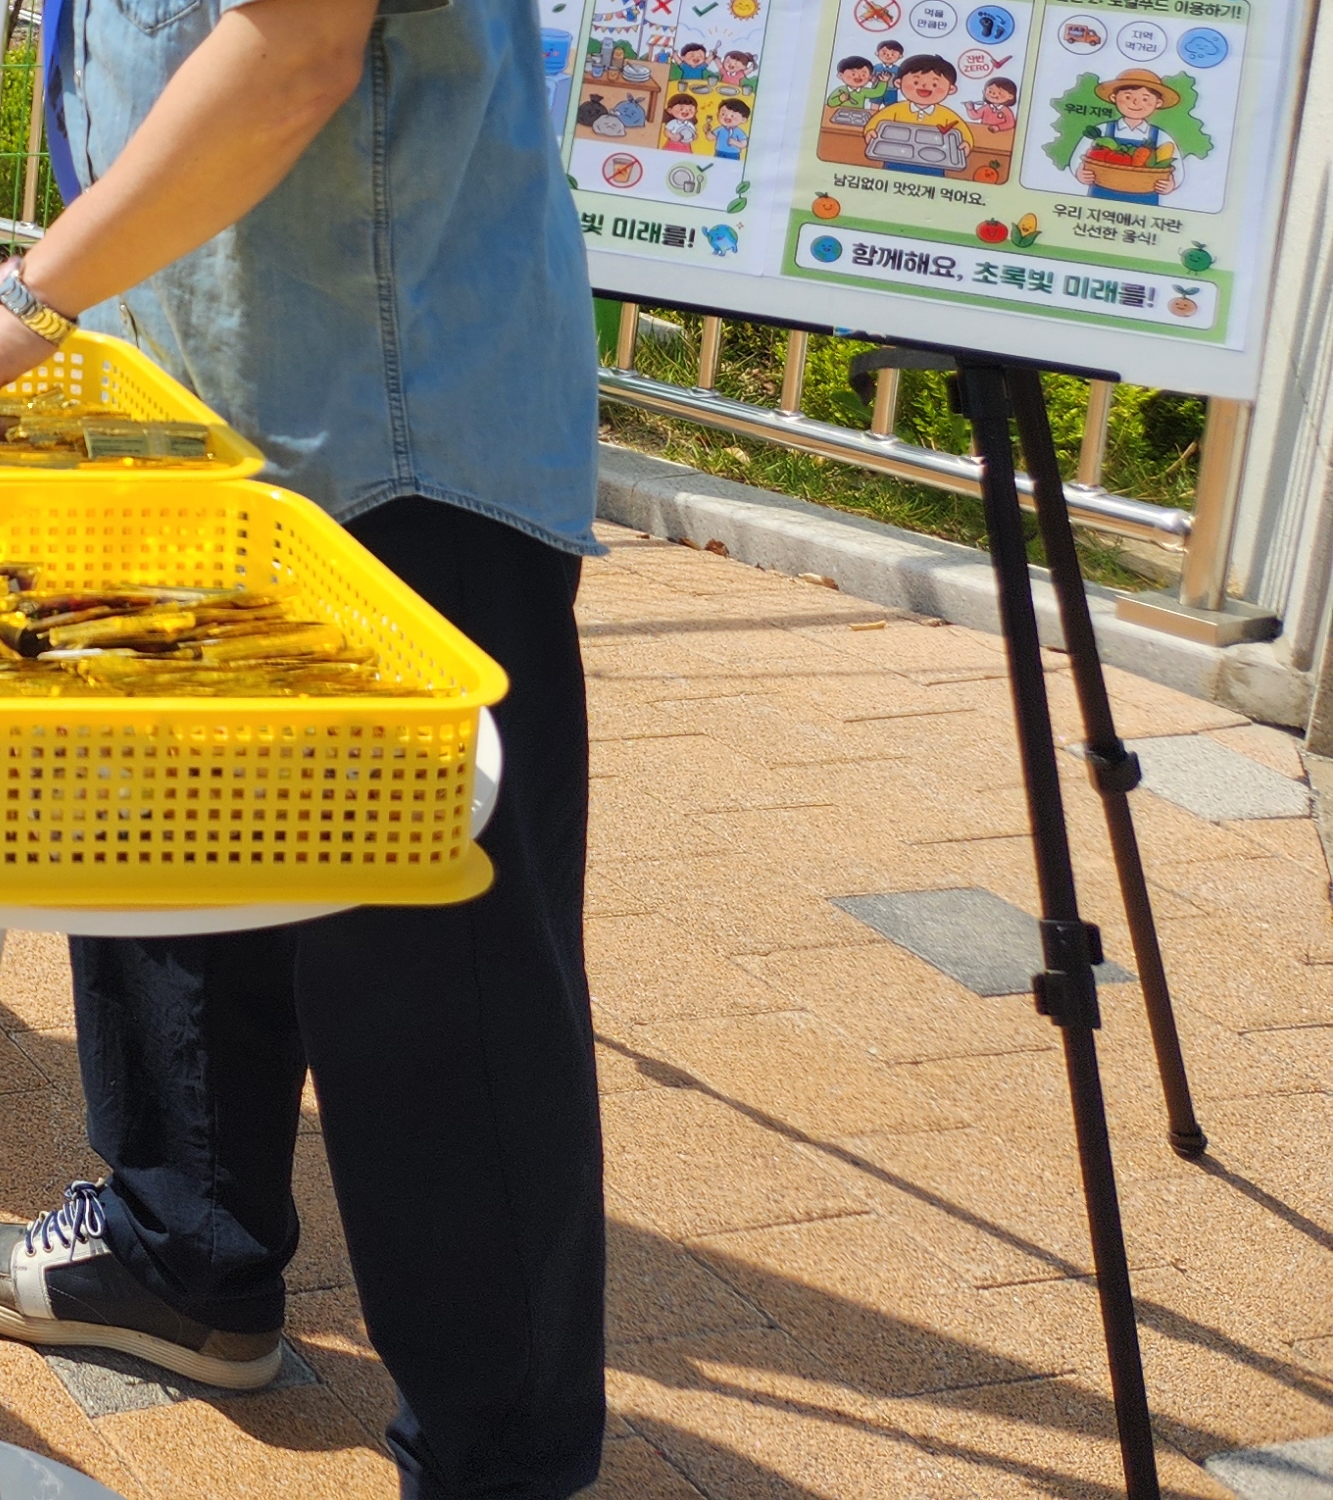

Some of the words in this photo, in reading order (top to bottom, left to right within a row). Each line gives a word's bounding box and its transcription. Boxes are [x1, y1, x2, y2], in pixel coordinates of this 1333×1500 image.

[923, 7, 943, 18] 먹을
[1130, 29, 1154, 41] 지역
[1123, 40, 1157, 53] 먹거리
[965, 54, 986, 65] 잔반
[962, 62, 990, 74] ZERO
[1063, 102, 1087, 116] 우리
[1088, 103, 1113, 118] 지역
[832, 173, 889, 193] 남김없이
[892, 181, 936, 200] 맛있게
[939, 185, 987, 207] 먹어요.
[1052, 202, 1083, 220] 우리
[1086, 206, 1147, 227] 지역에서
[1150, 215, 1183, 234] 자란
[611, 217, 696, 248] 미래를!
[1072, 223, 1118, 242] 신선한
[1121, 228, 1159, 246] 음식!
[851, 241, 964, 282] 함께해요,
[971, 259, 1055, 294] 초록빛
[1062, 274, 1156, 309] 미래를!
